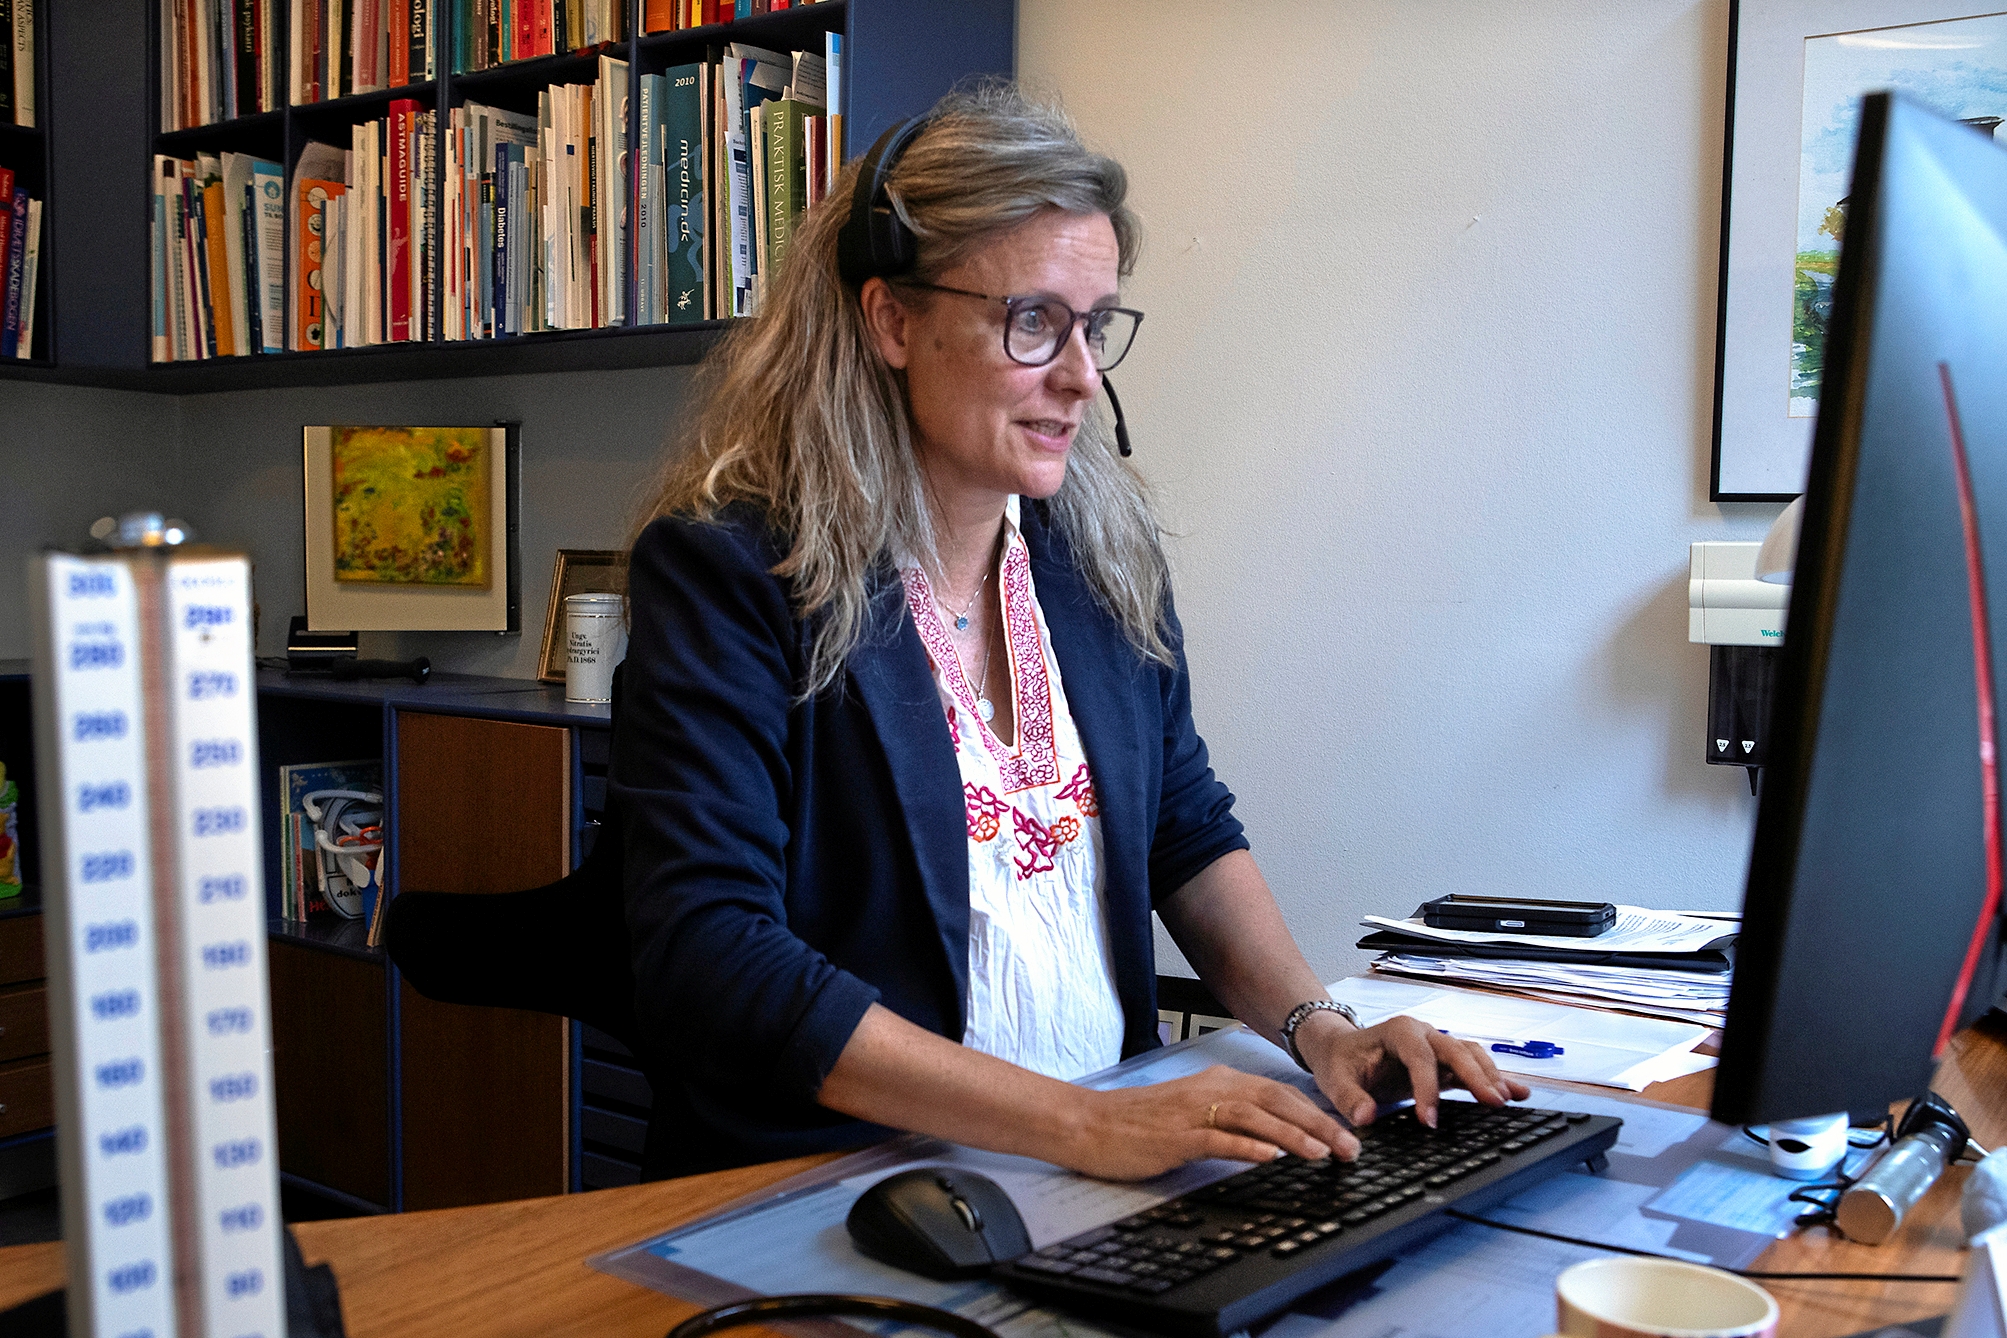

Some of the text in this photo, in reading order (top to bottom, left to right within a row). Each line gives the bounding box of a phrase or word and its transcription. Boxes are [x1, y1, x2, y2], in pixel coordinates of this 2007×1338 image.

[243, 10, 255, 53] psykiatri
[674, 76, 695, 87] 2010
[398, 113, 407, 202] ASTMAGUIDE
[640, 88, 649, 199] PATIENTVEJLEDNINGEN
[773, 110, 785, 193] PRAKTISK
[497, 207, 506, 248] Diabetes
